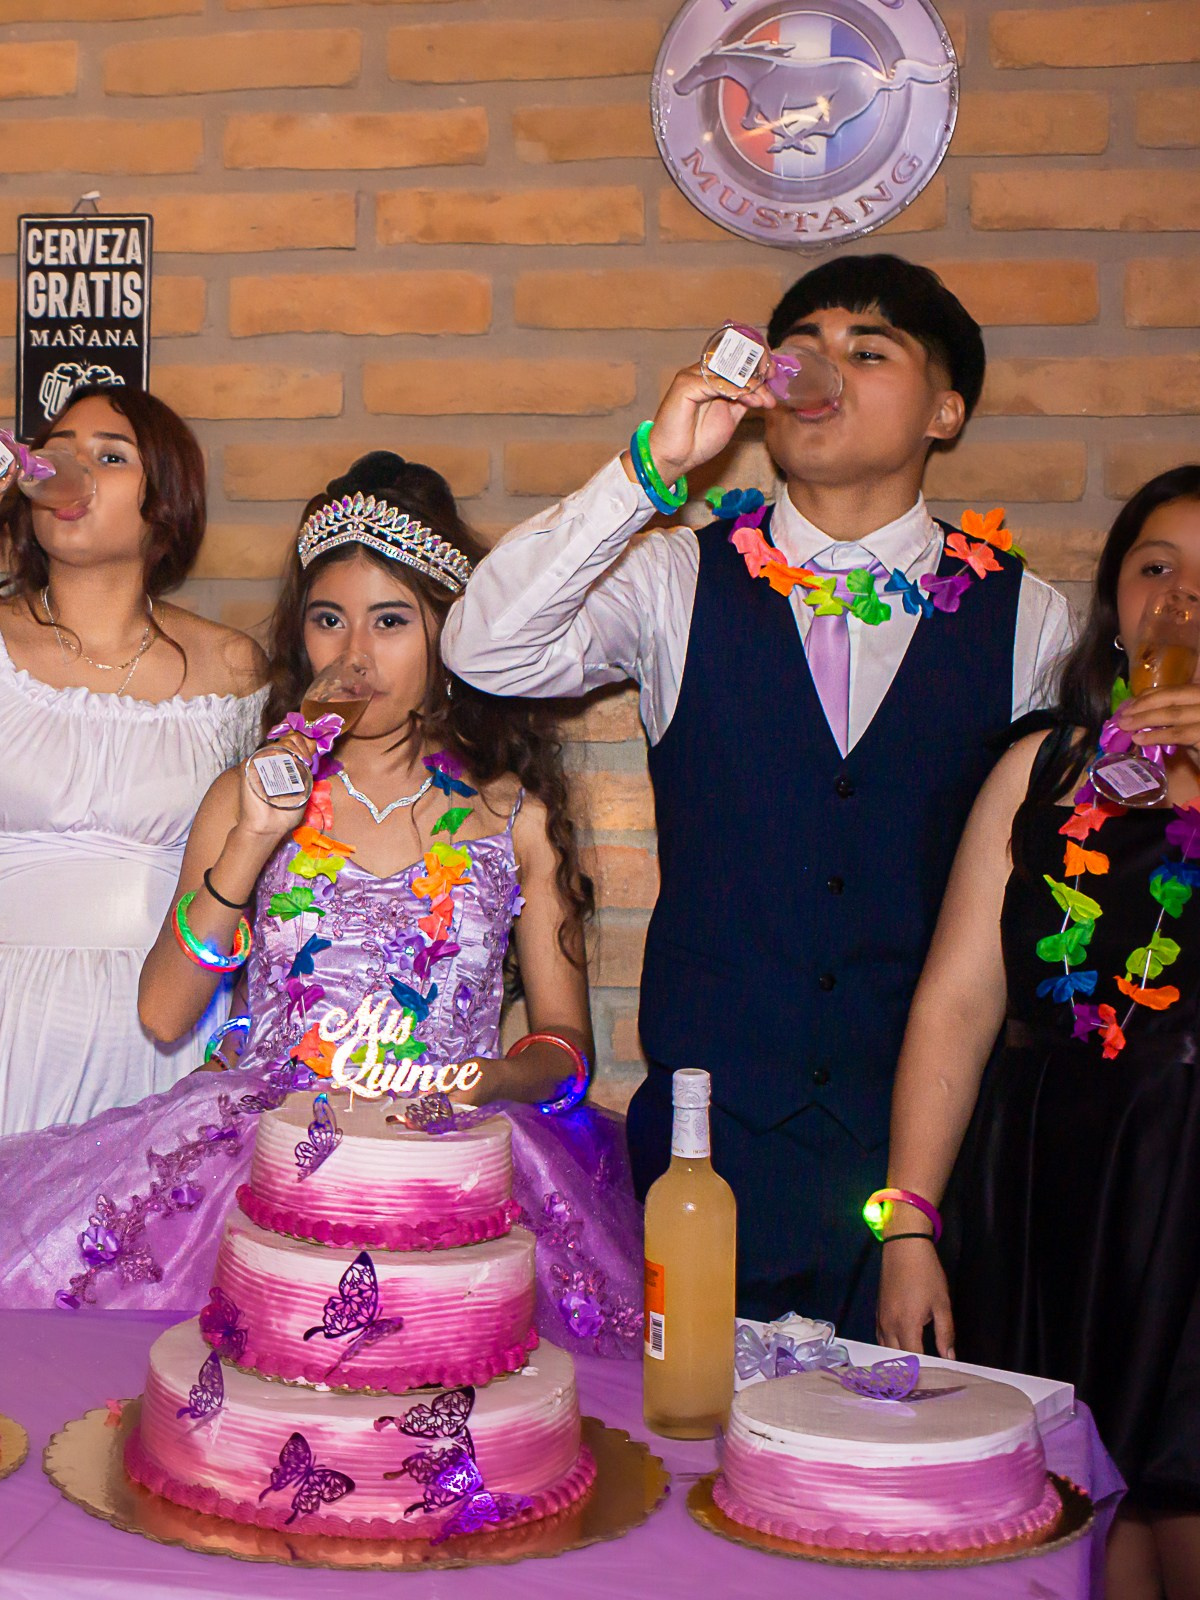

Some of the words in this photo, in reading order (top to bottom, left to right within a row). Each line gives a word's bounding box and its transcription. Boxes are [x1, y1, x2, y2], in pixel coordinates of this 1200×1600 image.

[681, 148, 923, 232] MUSTANG
[27, 228, 142, 266] CERVEZA
[27, 271, 142, 318] GRATIS
[30, 324, 138, 347] MAÑANA
[318, 994, 414, 1045] Mis
[331, 1037, 483, 1098] Quince
